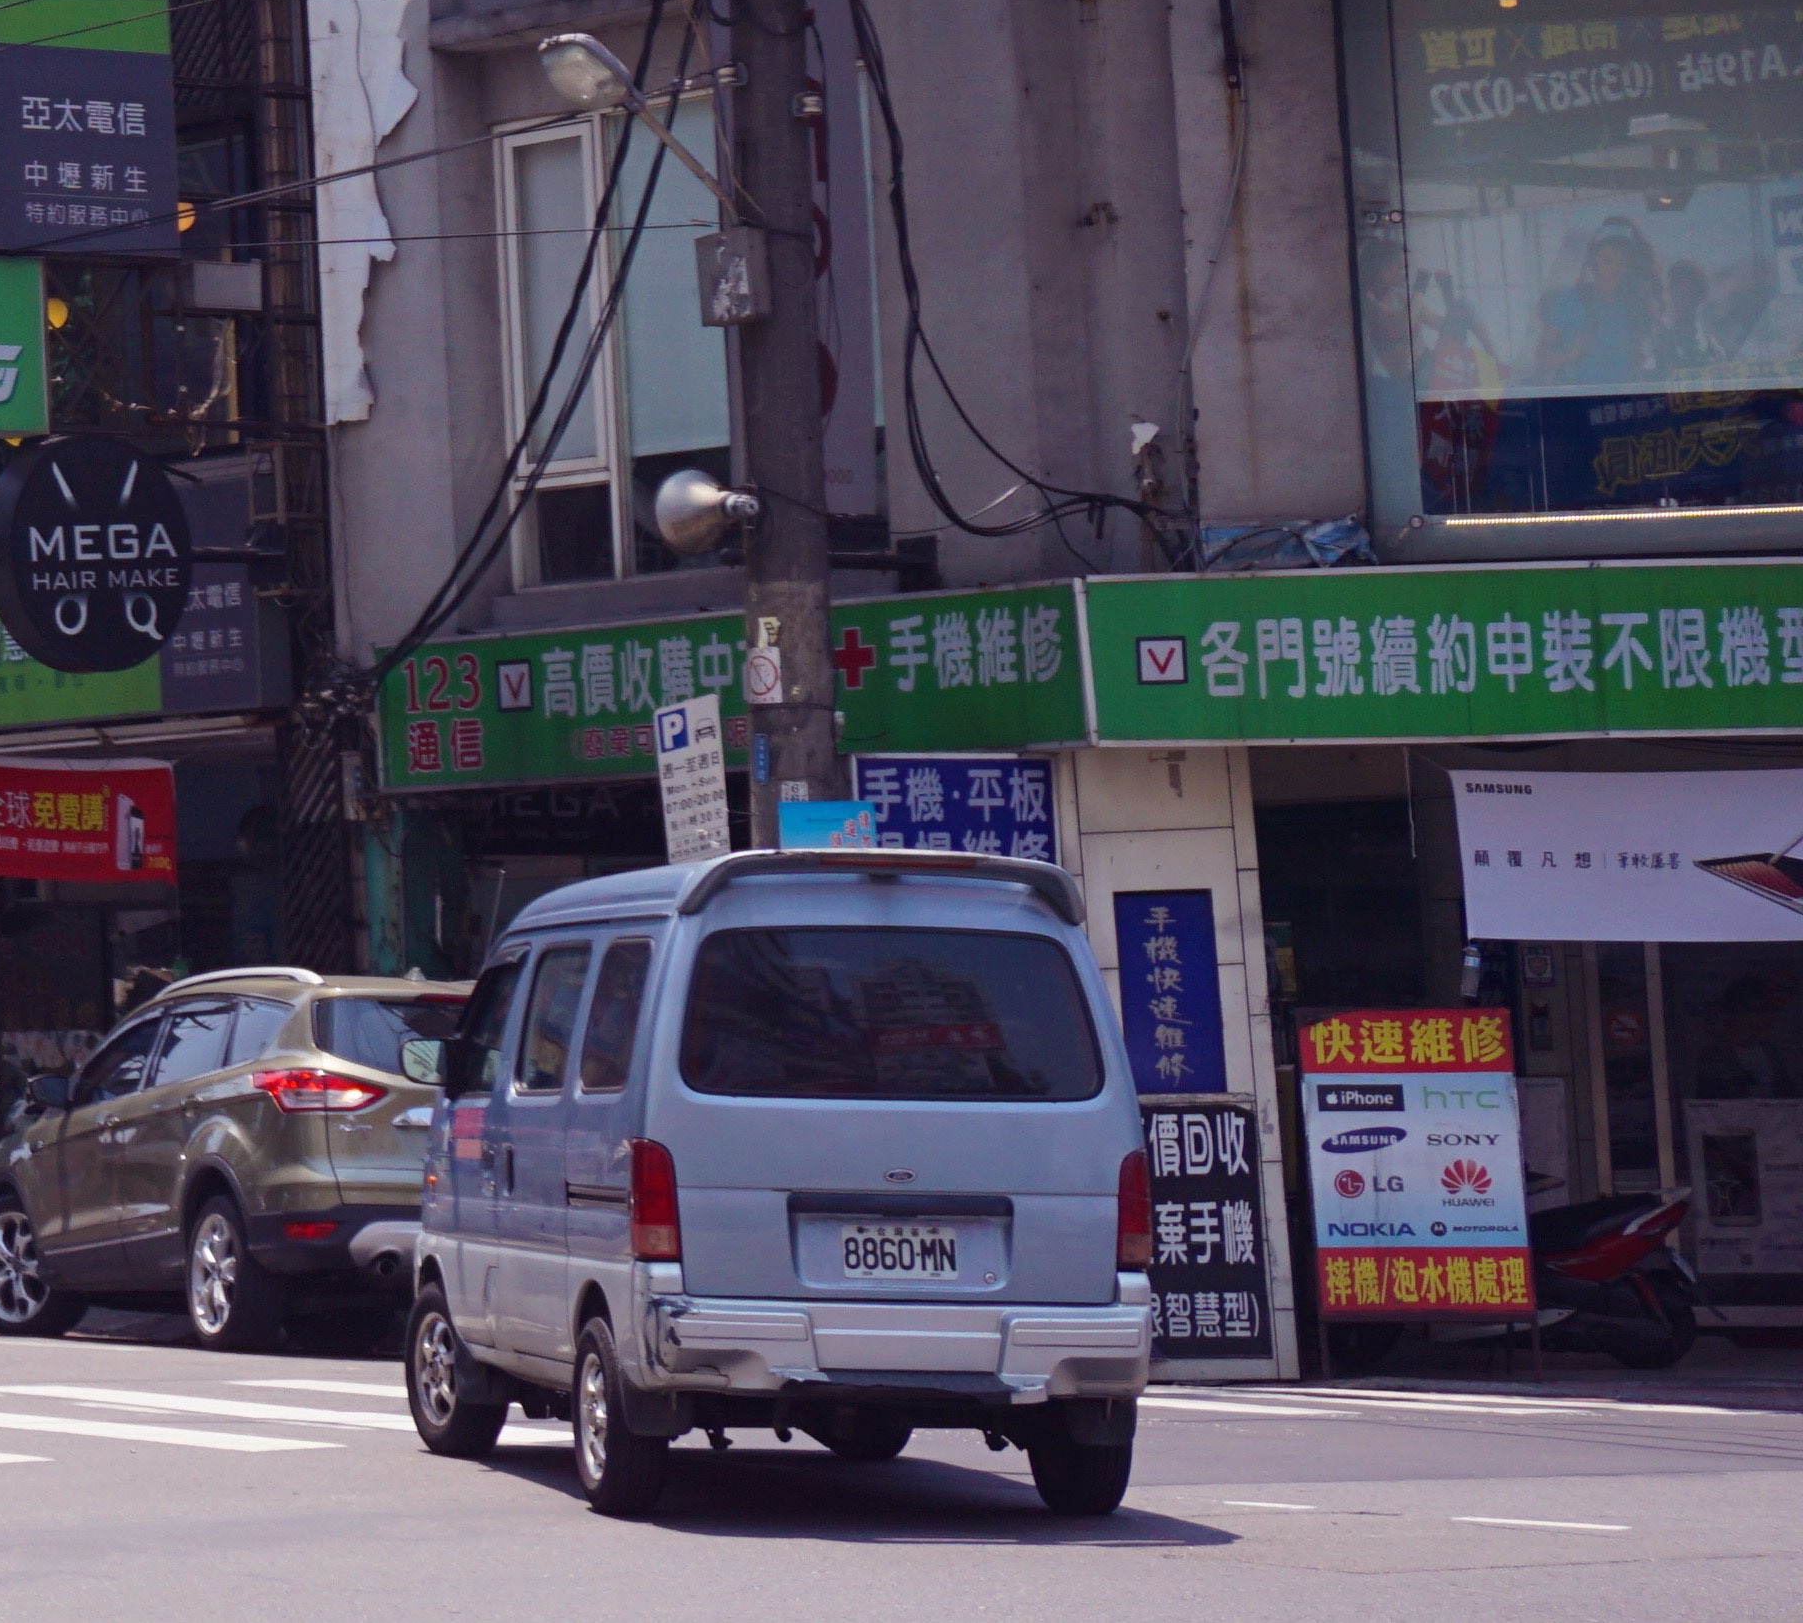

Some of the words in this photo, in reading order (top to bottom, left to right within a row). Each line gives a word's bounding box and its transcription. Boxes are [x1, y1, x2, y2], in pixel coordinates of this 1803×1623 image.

[19, 92, 148, 139] 亞太電信
[23, 158, 149, 194] 中壢新生
[24, 198, 151, 231] 特約服務中心
[27, 522, 179, 564] MEGA
[32, 571, 97, 592] HAIR
[107, 567, 182, 589] MAKE
[888, 603, 1063, 693] 手機維修
[401, 654, 483, 715] 123
[540, 633, 747, 719] 高價收購中
[406, 719, 484, 775] 通信
[661, 750, 721, 779] 週一至週日
[1464, 781, 1534, 797] SAMSUNG
[1142, 905, 1194, 1080] 手機快速維修
[1309, 1015, 1508, 1069] 快速維修
[1339, 1088, 1394, 1107] iPhone
[1147, 1112, 1251, 1177] 價回收
[1330, 1132, 1398, 1147] SAMSUNG
[1425, 1133, 1501, 1147] SONY
[1441, 1198, 1496, 1207] HUAWEI
[1150, 1199, 1257, 1269] 棄手機
[1327, 1221, 1417, 1239] NOKIA
[1451, 1223, 1520, 1234] MOTOROLA
[1325, 1255, 1530, 1306] 摔機/泡水機處理
